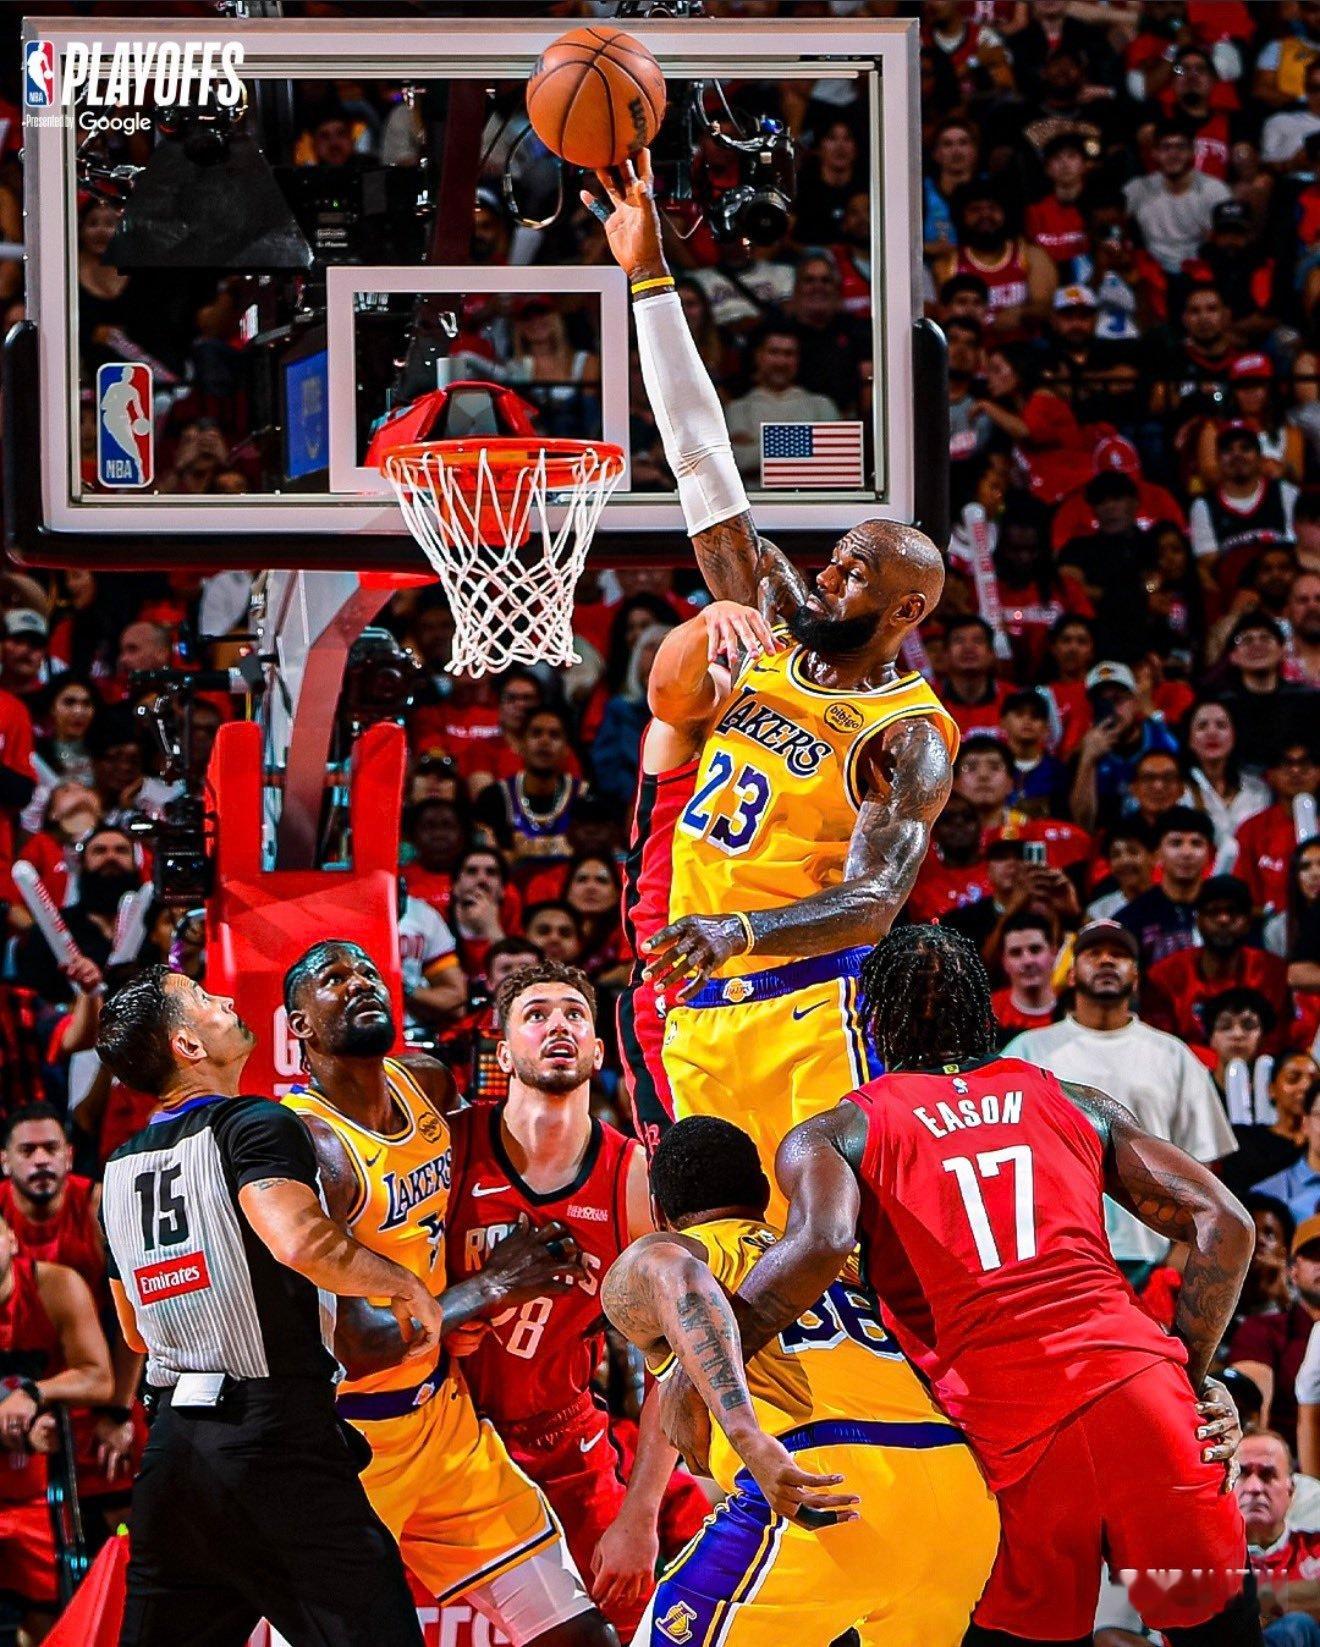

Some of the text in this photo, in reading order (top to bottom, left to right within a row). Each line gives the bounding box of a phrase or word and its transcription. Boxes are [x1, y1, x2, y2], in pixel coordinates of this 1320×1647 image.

[105, 459, 133, 479] NBA
[713, 685, 834, 779] LAKERS
[830, 705, 860, 729] bibigo
[677, 750, 773, 857] 23
[912, 1090, 1024, 1139] EASON
[134, 1161, 190, 1252] 15
[941, 1143, 1037, 1272] 17
[140, 1265, 201, 1295] Emirates
